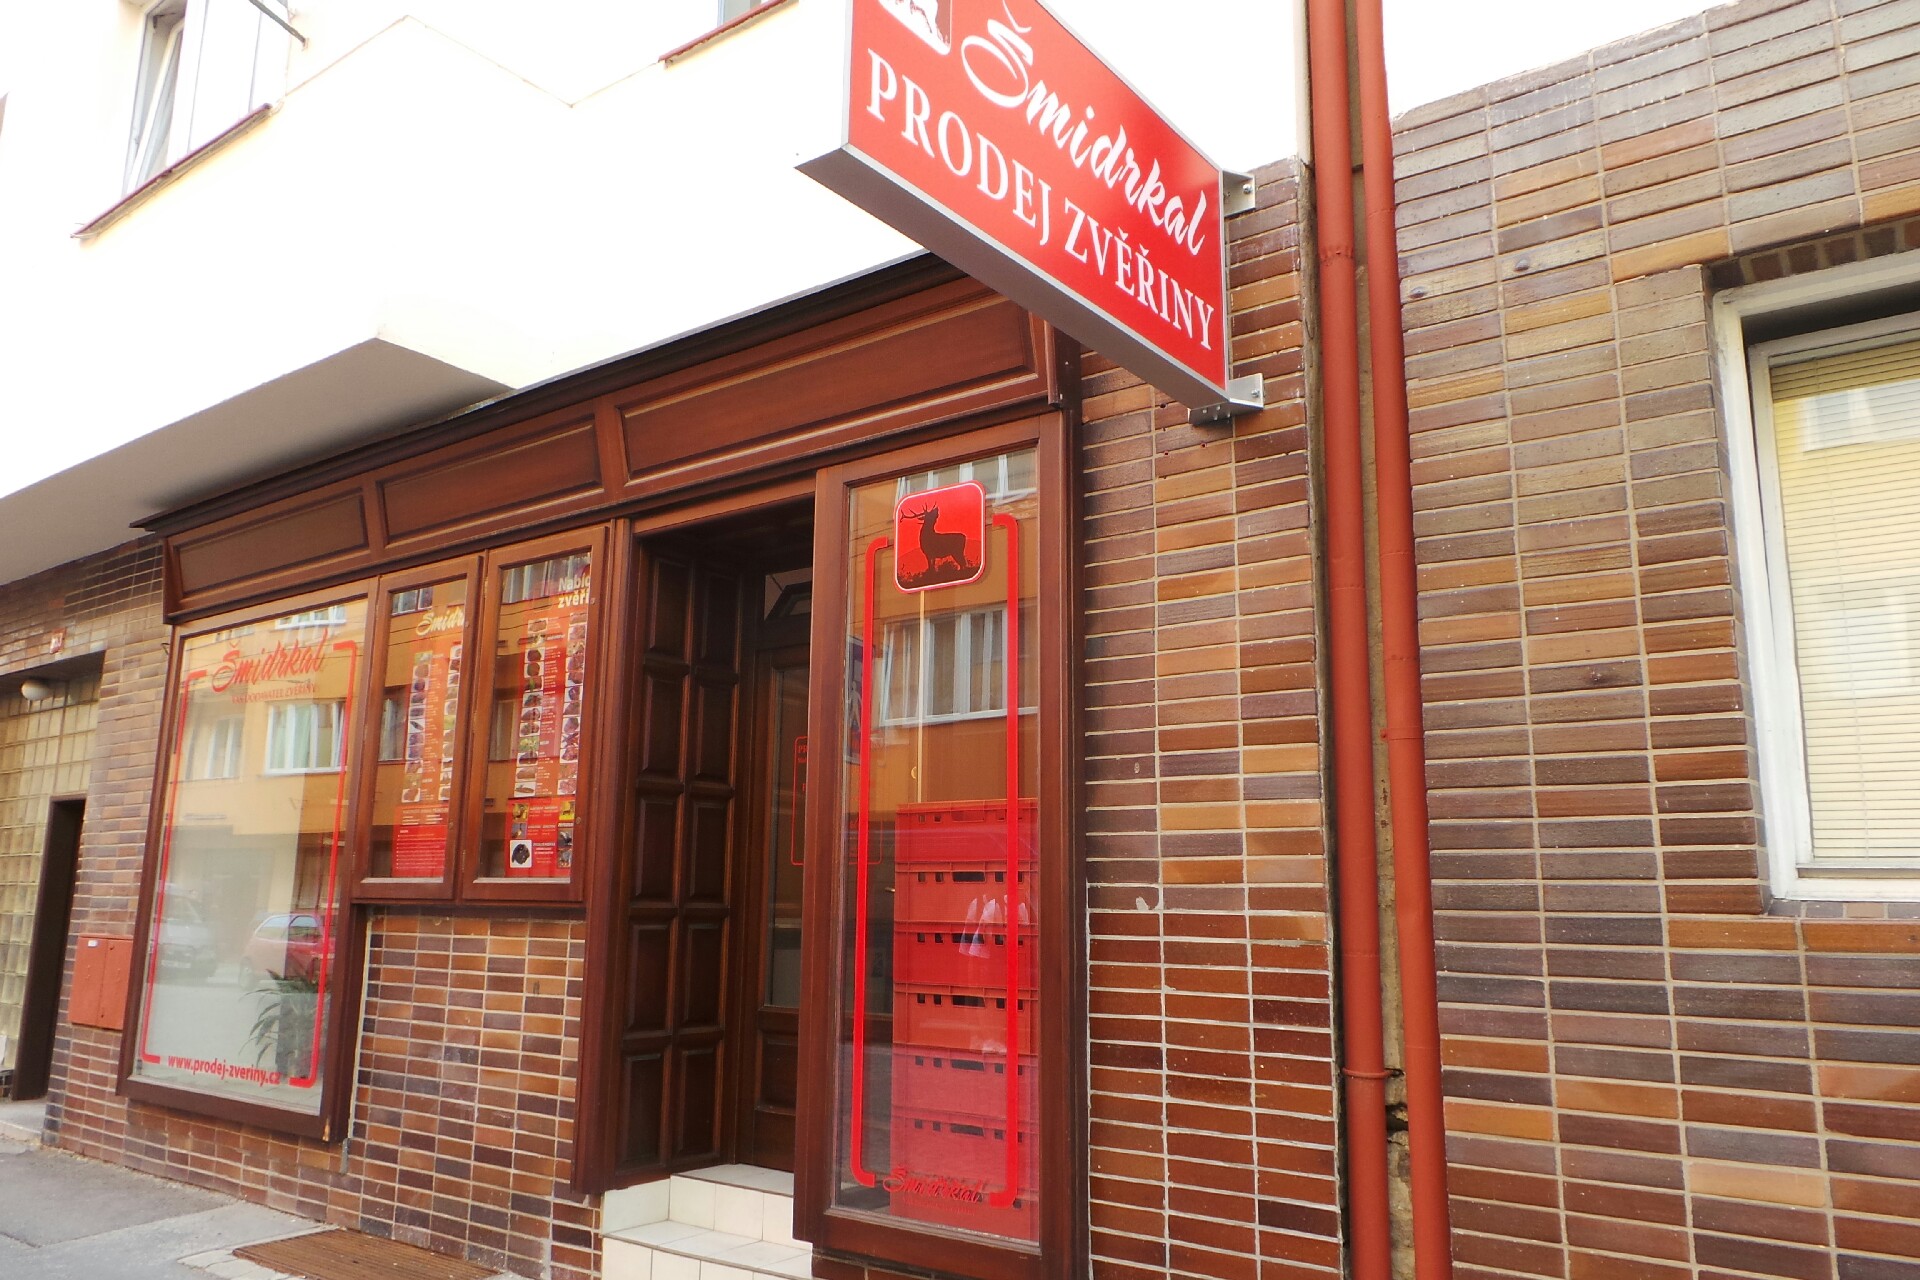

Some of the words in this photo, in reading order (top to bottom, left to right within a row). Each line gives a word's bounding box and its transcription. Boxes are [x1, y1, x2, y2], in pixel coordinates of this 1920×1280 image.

[866, 48, 1052, 246] PRODEJ
[1064, 197, 1215, 351] ZVĚŘINY
[961, 0, 1206, 255] Šmidrkal
[211, 628, 328, 692] Šmidrkal
[168, 1055, 282, 1087] www.prodej-zveriny.cz
